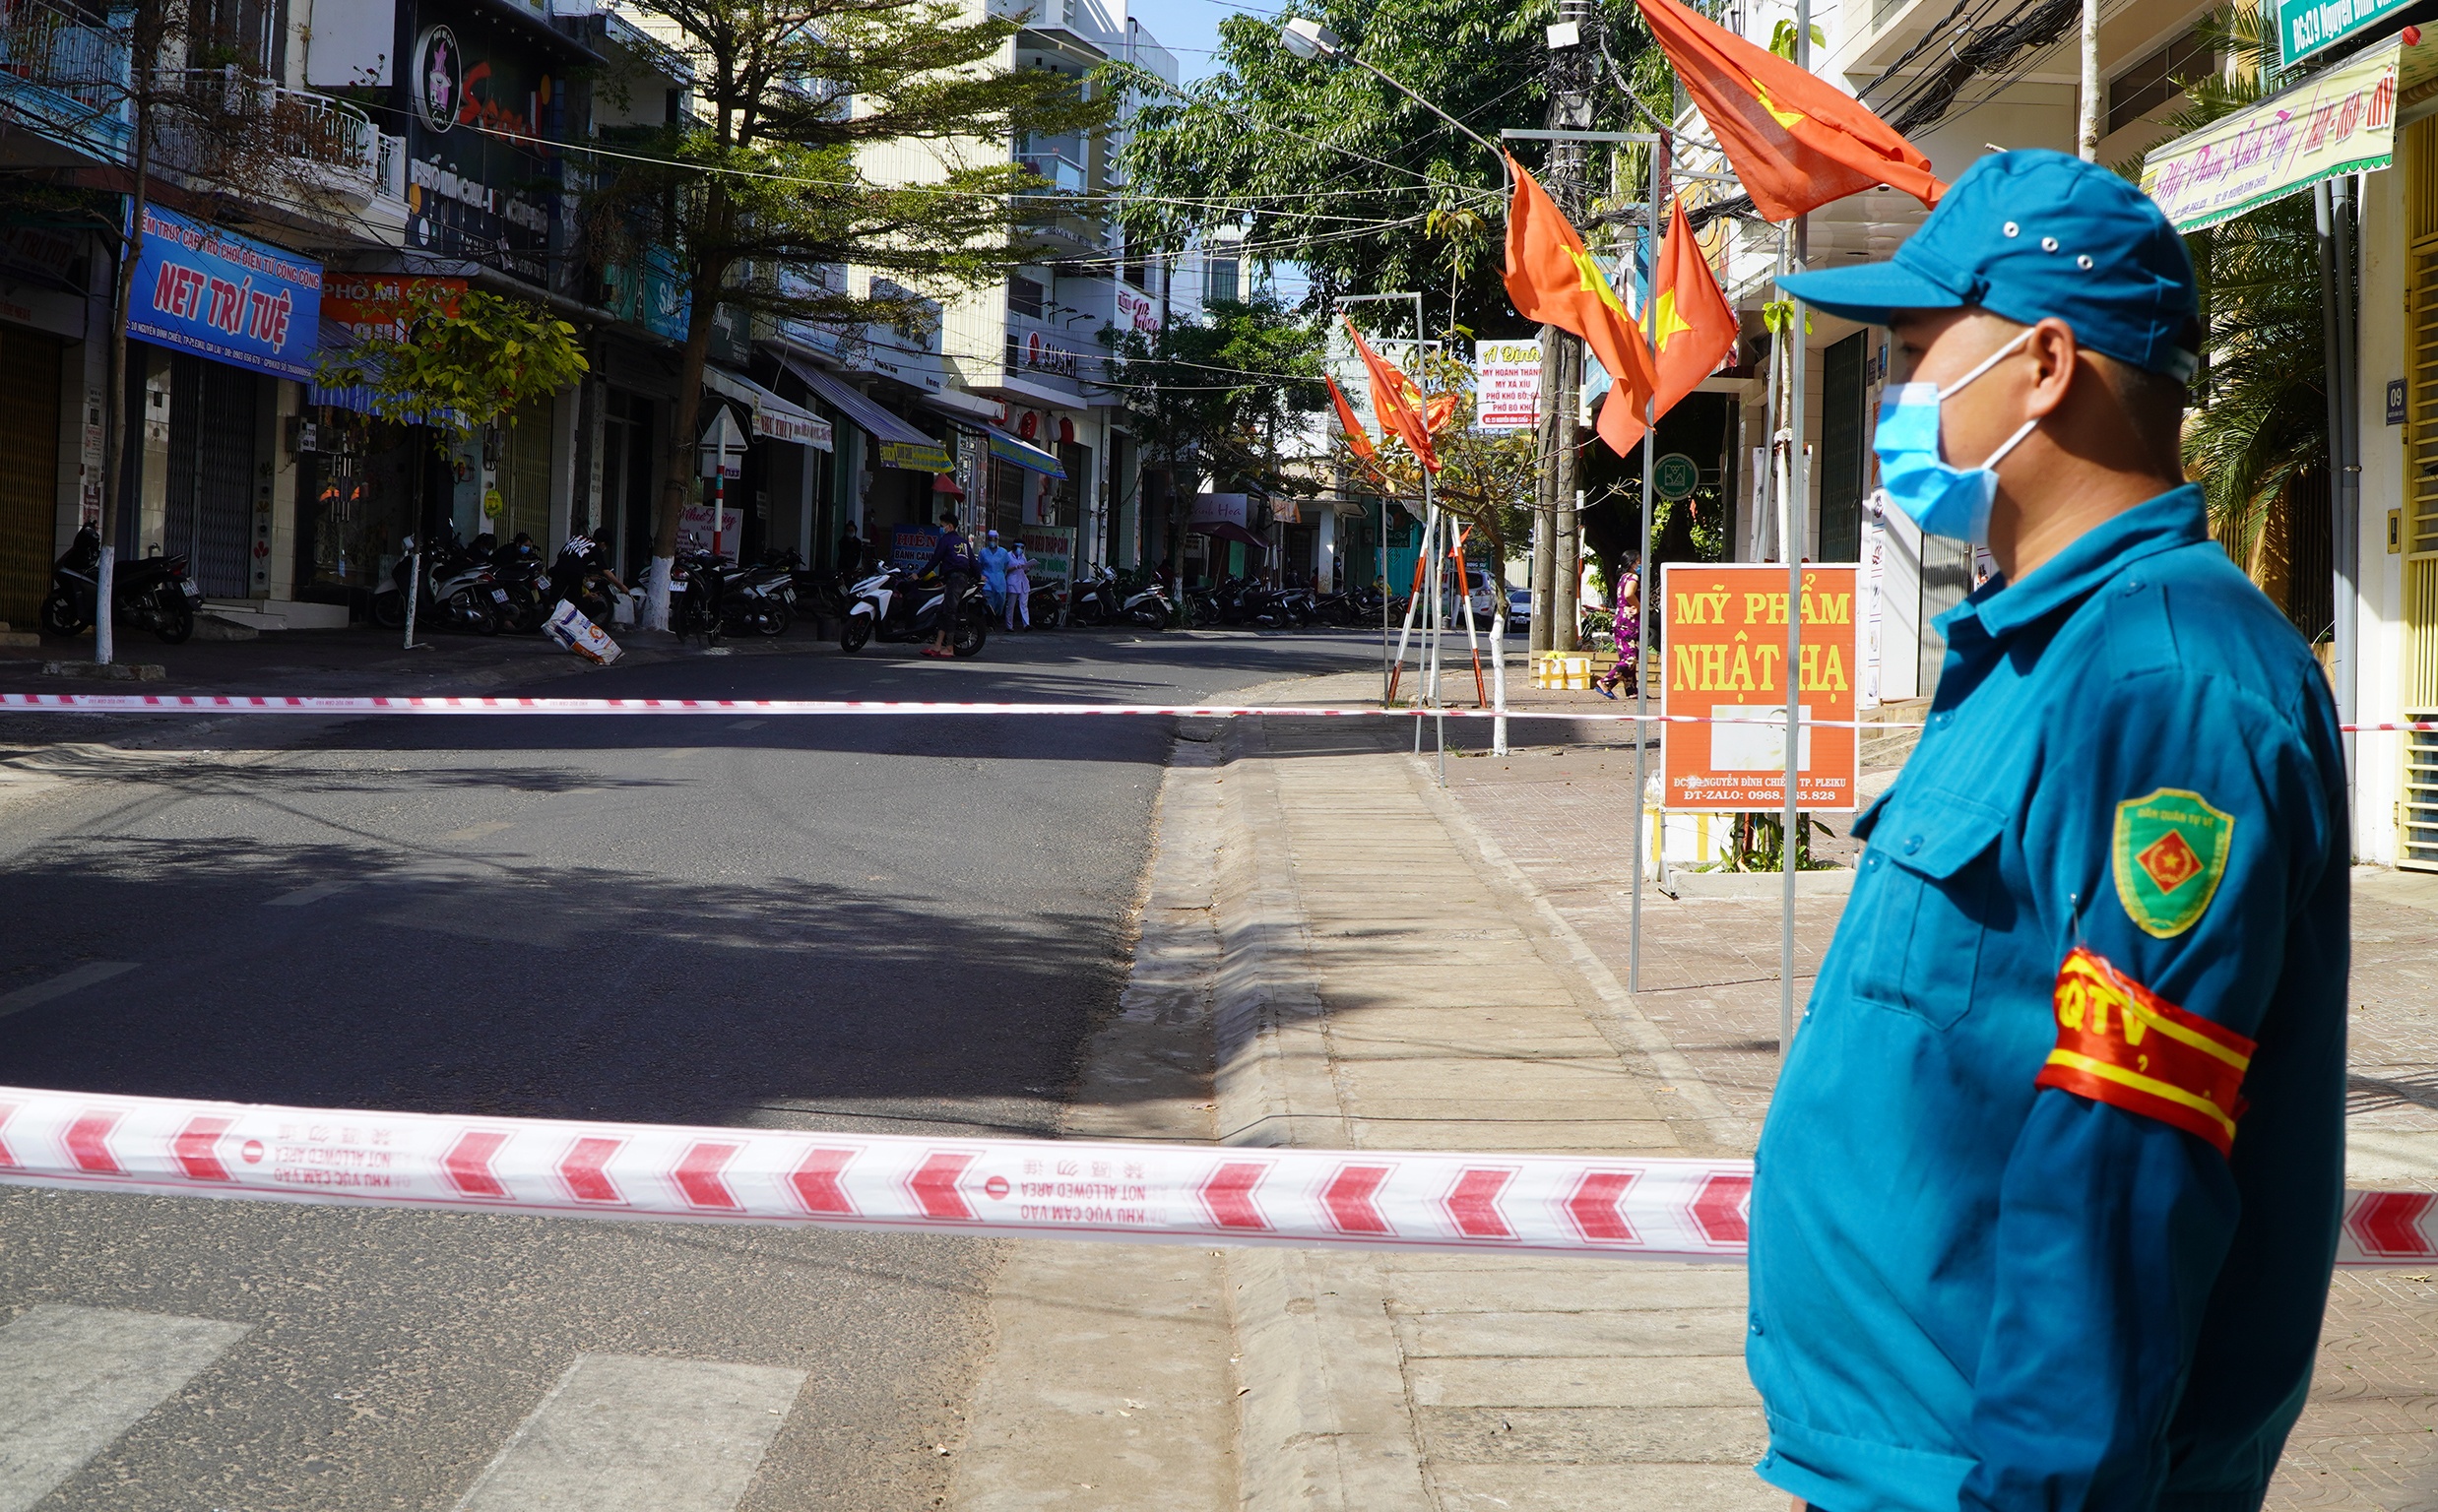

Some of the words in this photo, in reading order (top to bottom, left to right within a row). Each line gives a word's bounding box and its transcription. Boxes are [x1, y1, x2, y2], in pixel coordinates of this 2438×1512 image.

[153, 260, 206, 322] NET
[207, 275, 252, 336] TRÍ
[248, 287, 293, 354] TUỆ
[1483, 346, 1499, 364] A
[1501, 345, 1542, 365] Định
[2390, 388, 2403, 407] 09
[1218, 504, 1242, 517] Hoa
[896, 528, 938, 547] HIỀN
[1675, 584, 1732, 624] MỸ
[1743, 573, 1851, 624] PHẨM
[1673, 629, 1781, 704] NHẬT
[1798, 644, 1849, 704] HẠ
[1703, 773, 1739, 788] NGUYỄN
[1741, 775, 1763, 788] ĐÌNH
[1764, 773, 1787, 788] CHIỂ
[1799, 779, 1814, 788] TP.
[1815, 779, 1846, 788] PLEIKU
[1684, 790, 1744, 800] ĐT-ZALO:
[1748, 790, 1836, 801] 0968.65.828
[2055, 978, 2148, 1046] QTV
[1021, 1182, 1053, 1197] AREA
[1058, 1183, 1116, 1201] ALLOWED
[1121, 1186, 1145, 1201] NOT
[1118, 1209, 1145, 1224] KHU
